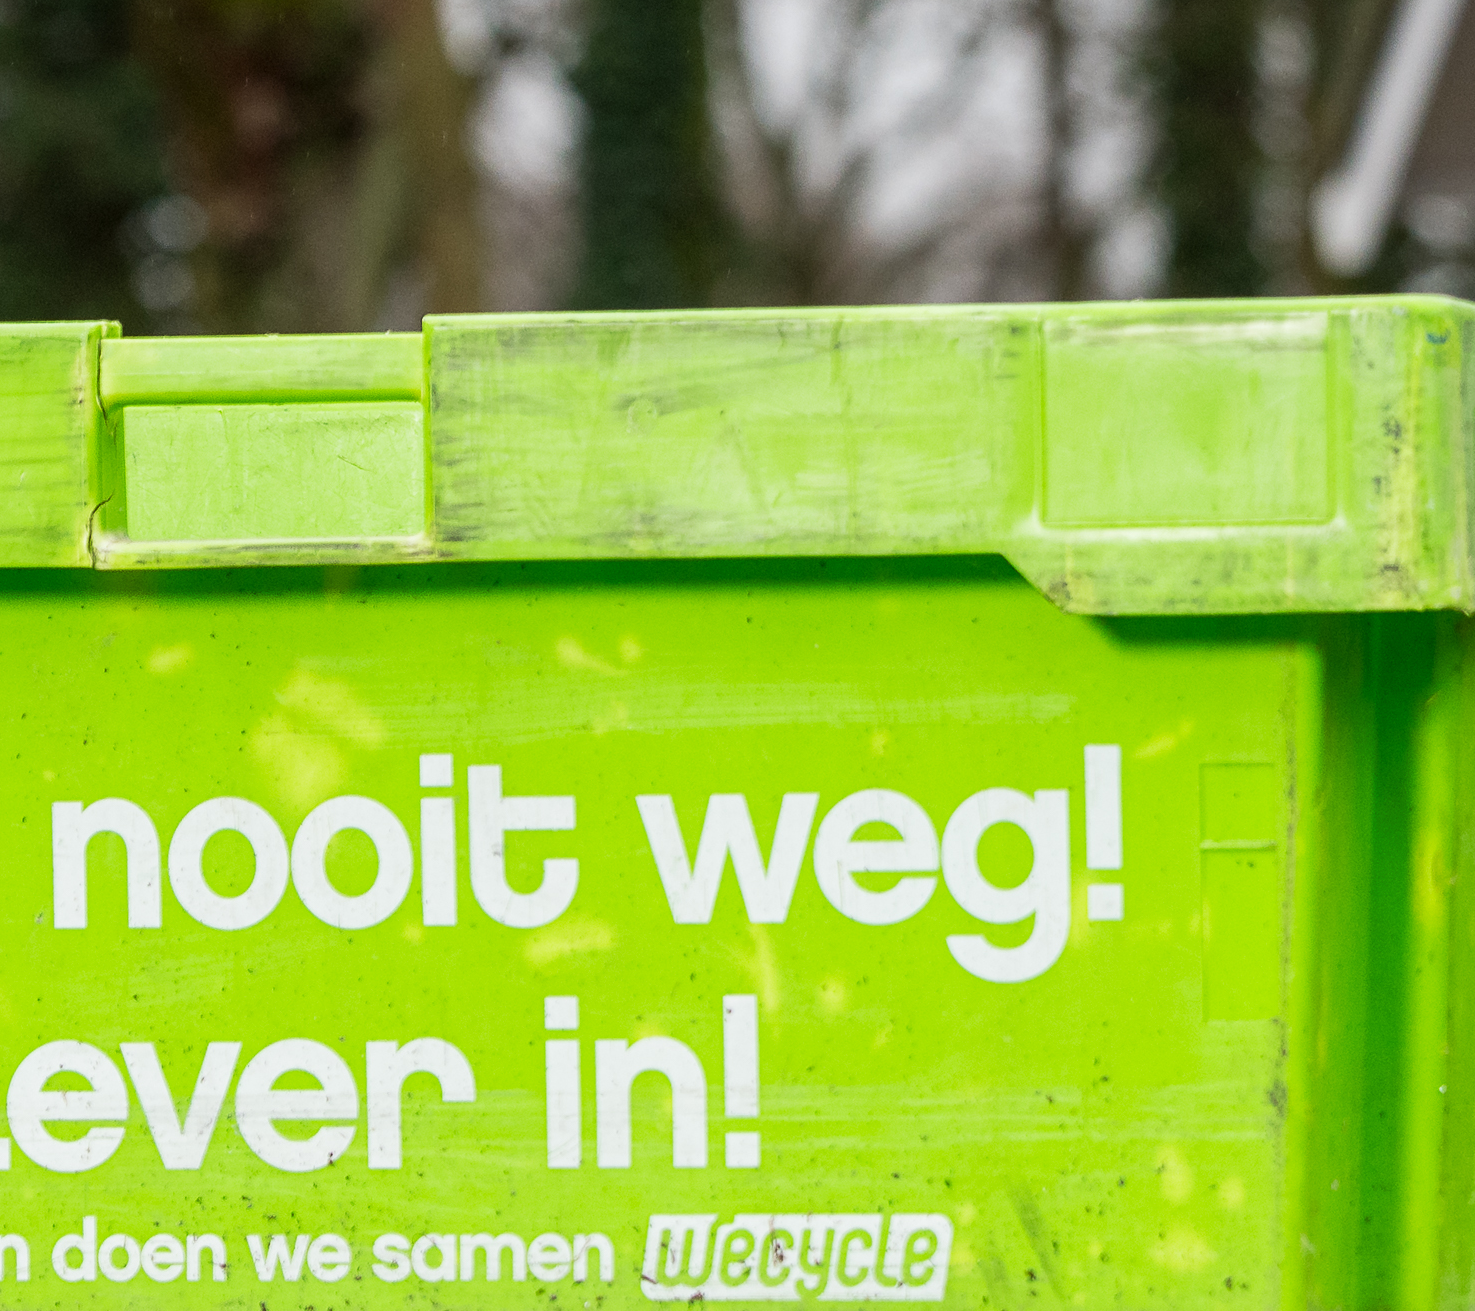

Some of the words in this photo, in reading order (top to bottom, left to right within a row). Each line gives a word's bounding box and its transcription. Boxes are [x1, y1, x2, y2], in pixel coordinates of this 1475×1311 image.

[51, 753, 580, 932] nooit
[634, 744, 1124, 984] weg!
[543, 993, 761, 1170] in!
[51, 1215, 228, 1284] doen
[246, 1232, 353, 1284] we
[371, 1232, 615, 1284] samen
